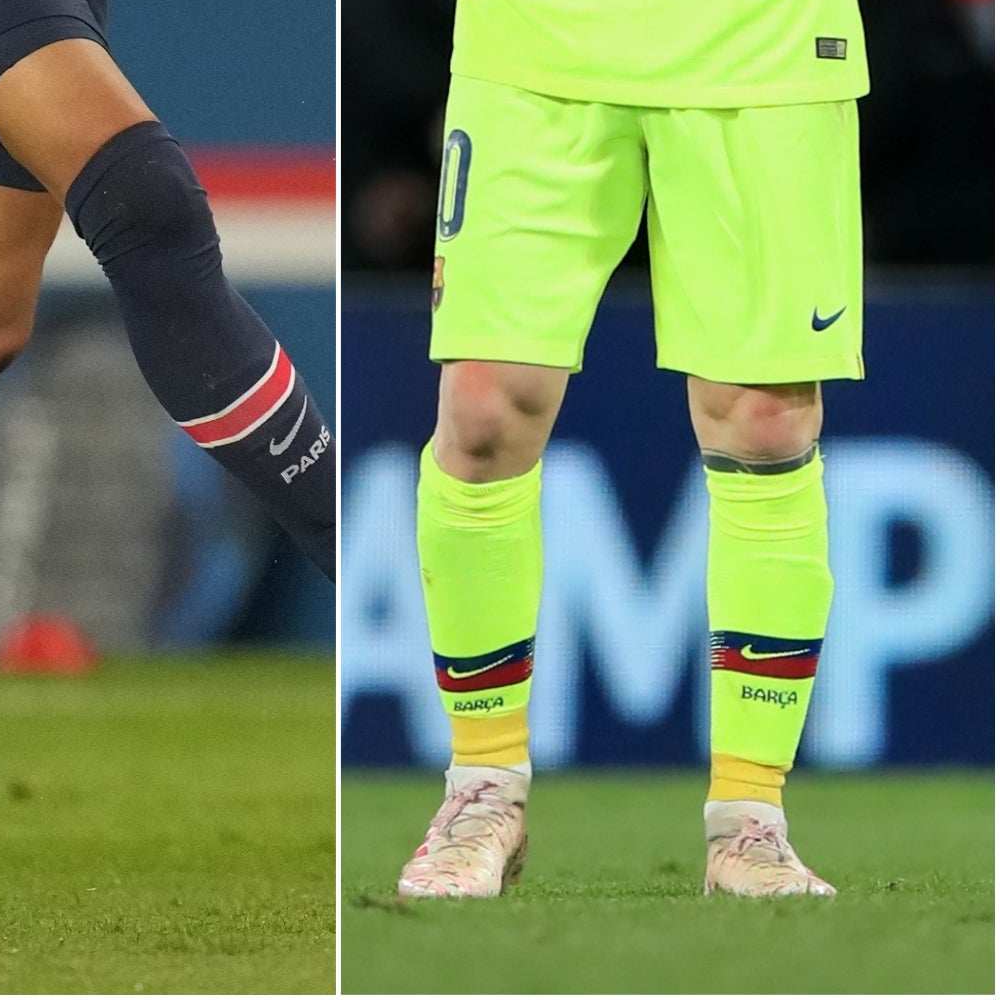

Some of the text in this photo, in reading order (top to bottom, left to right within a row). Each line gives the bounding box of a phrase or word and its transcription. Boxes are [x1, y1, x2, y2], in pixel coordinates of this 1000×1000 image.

[280, 425, 331, 484] PARIS
[454, 696, 504, 713] BARÇA
[742, 685, 798, 709] BARÇA
